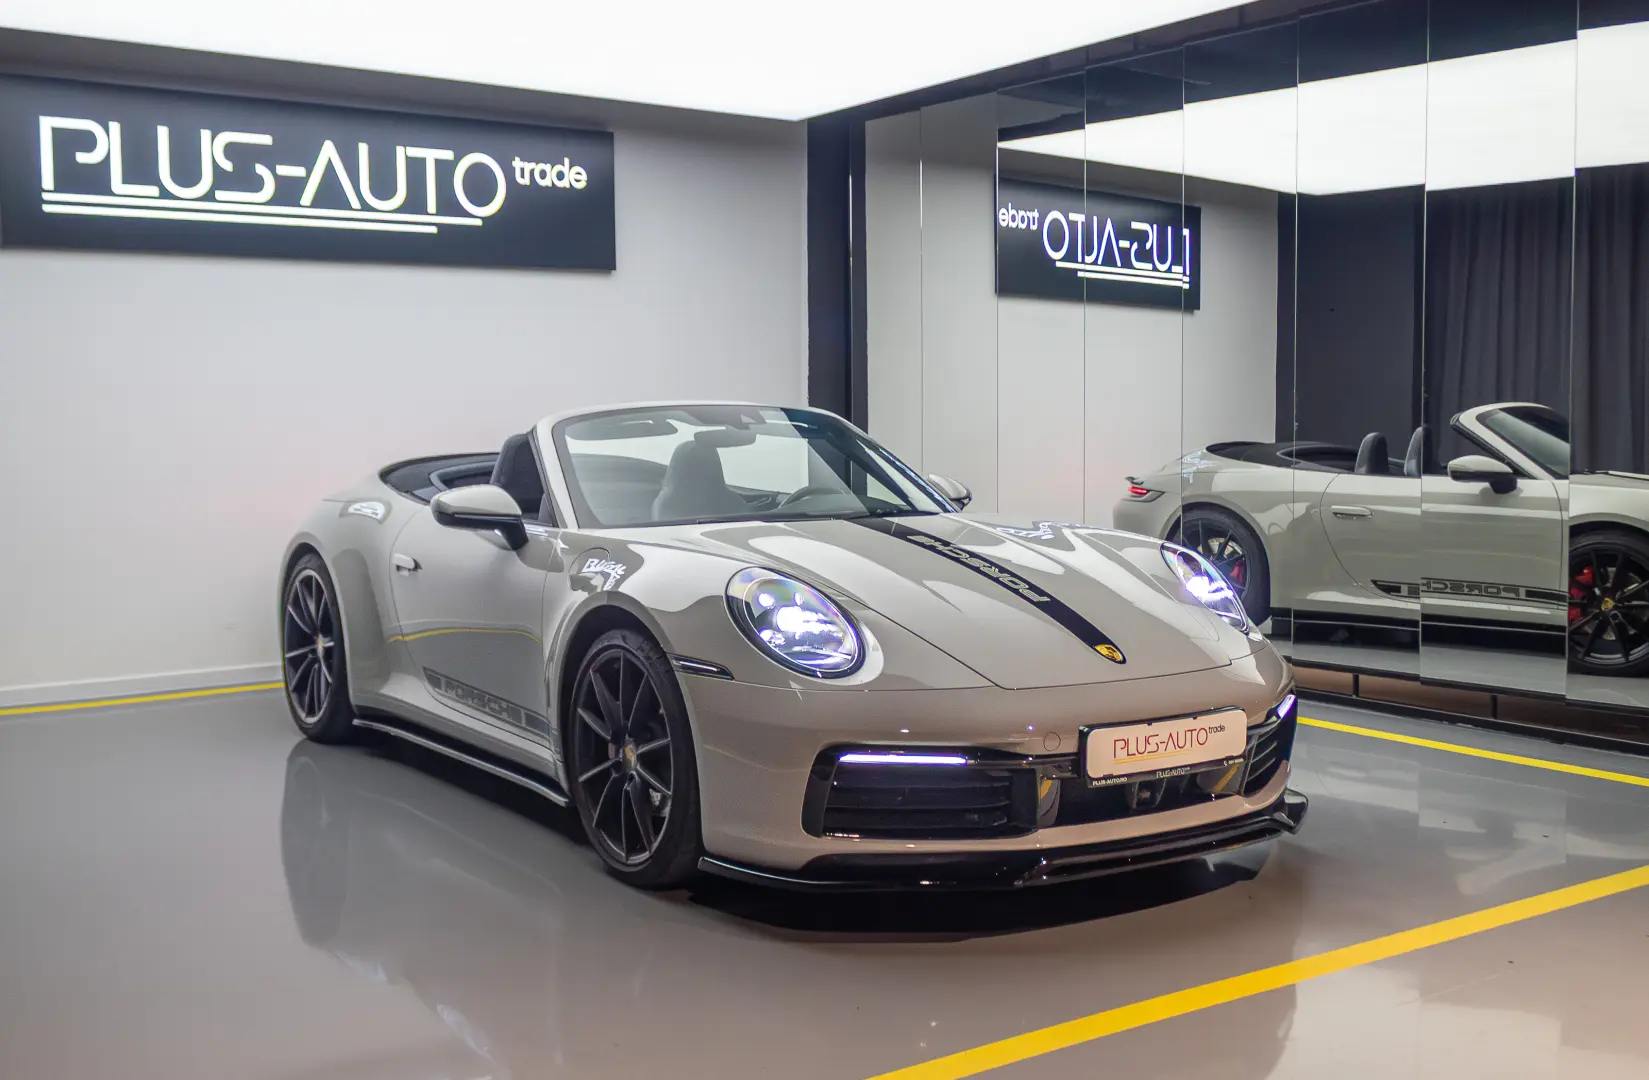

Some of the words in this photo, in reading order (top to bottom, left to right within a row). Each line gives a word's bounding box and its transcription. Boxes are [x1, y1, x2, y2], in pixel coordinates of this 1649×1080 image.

[39, 115, 508, 218] PLUS-AUTO
[511, 155, 588, 190] trade
[1113, 727, 1208, 759] PLUS-AUTO
[1208, 724, 1226, 735] trade
